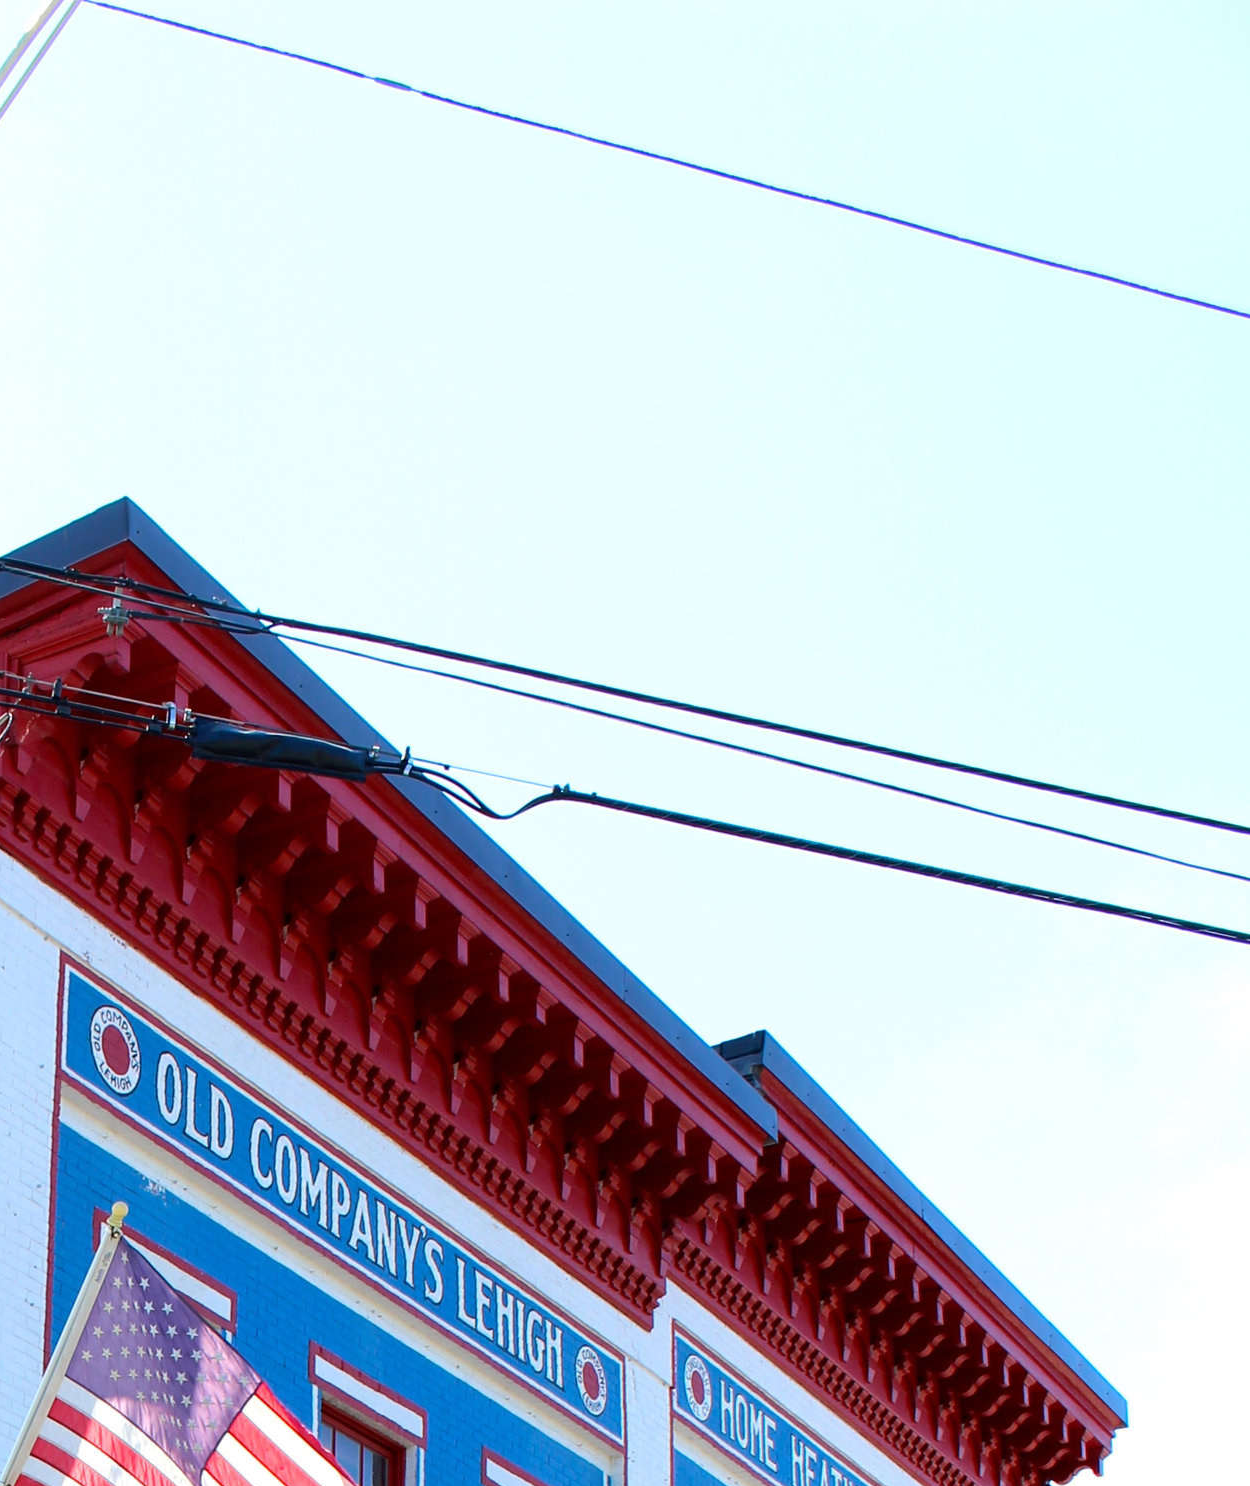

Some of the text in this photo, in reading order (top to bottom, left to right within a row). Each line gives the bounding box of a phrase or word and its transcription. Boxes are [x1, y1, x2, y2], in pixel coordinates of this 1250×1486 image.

[155, 1052, 566, 1392] OLD COMPANY'S LEHIGH
[719, 1377, 778, 1473] HOME
